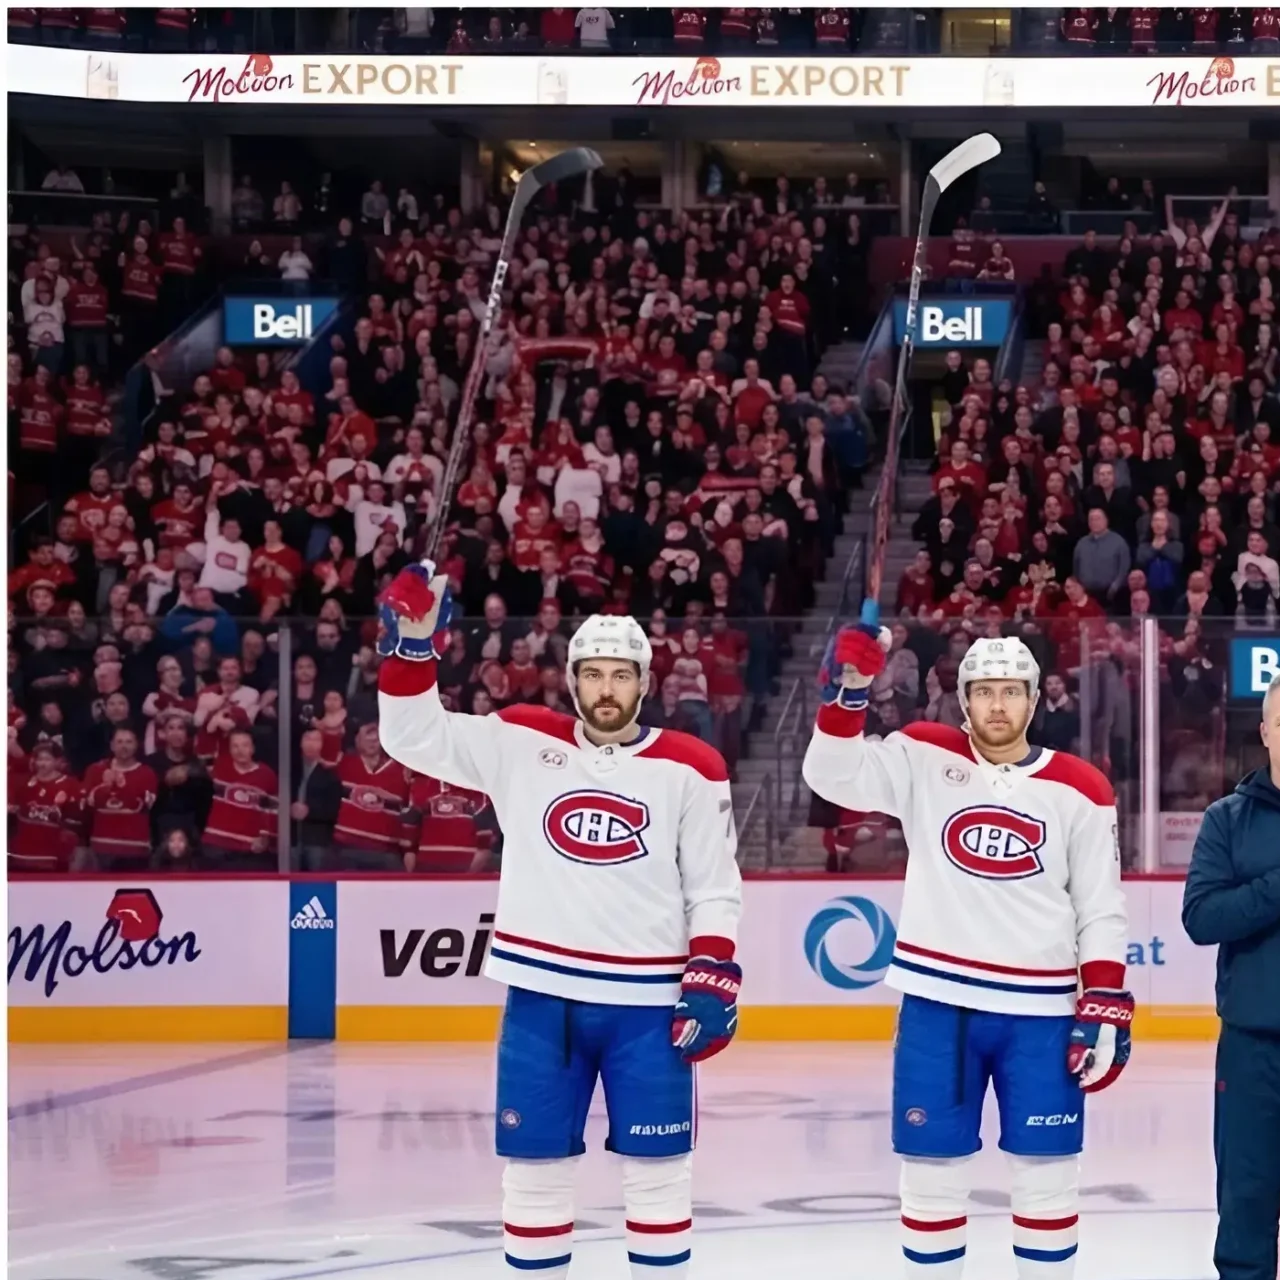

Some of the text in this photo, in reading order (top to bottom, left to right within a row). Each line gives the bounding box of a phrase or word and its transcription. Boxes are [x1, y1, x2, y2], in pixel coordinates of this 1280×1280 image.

[303, 63, 463, 95] EXPORT
[750, 65, 910, 96] EXPORT
[254, 304, 312, 338] Bell
[922, 306, 982, 341] Bell
[8, 919, 202, 998] Molson
